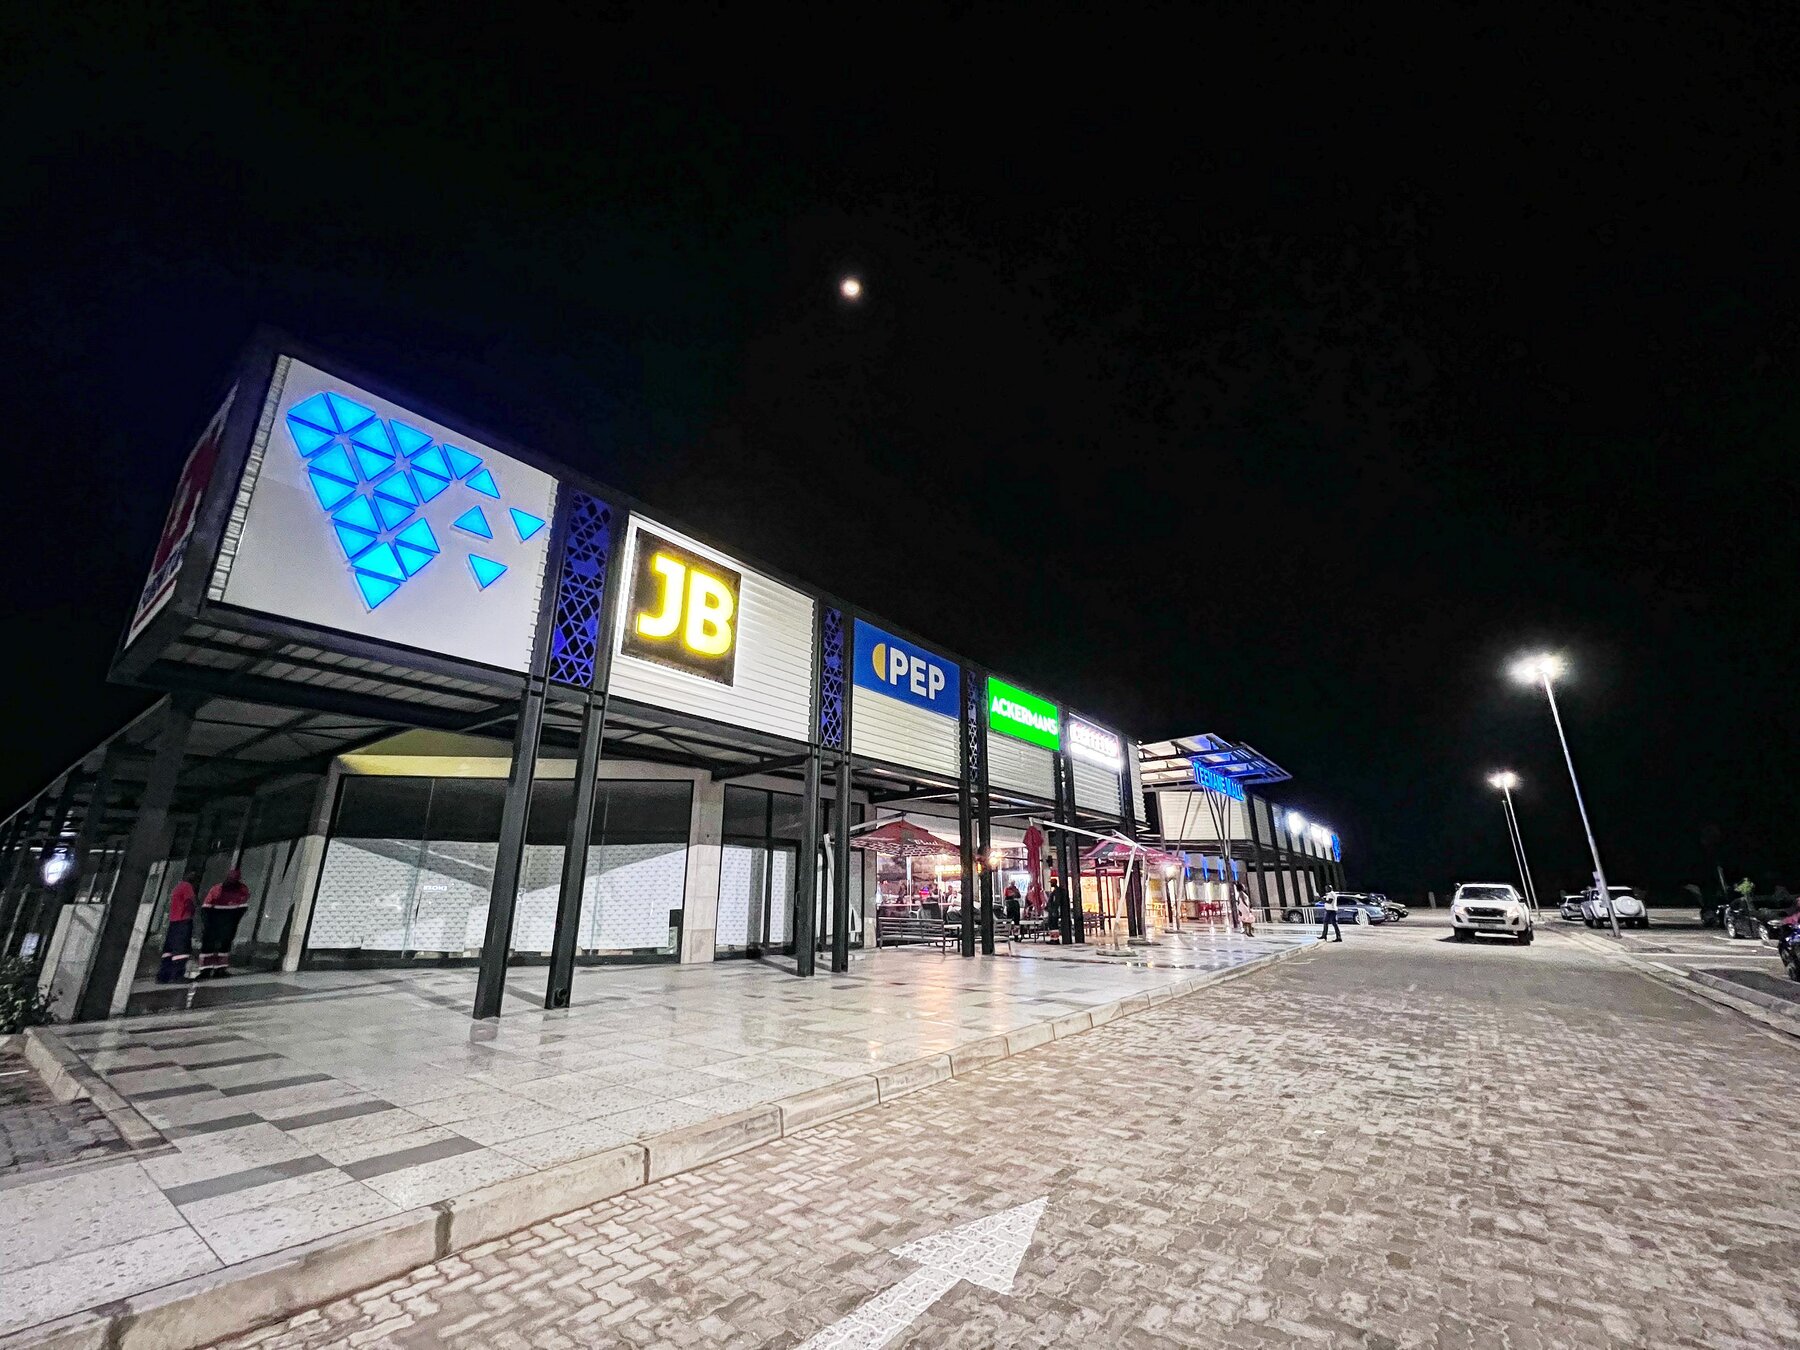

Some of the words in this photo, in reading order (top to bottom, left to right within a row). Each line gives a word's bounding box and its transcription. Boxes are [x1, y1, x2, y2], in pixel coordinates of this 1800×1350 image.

[636, 552, 735, 656] JB
[889, 648, 946, 699] PEP
[992, 696, 1058, 736] ACKERMANS
